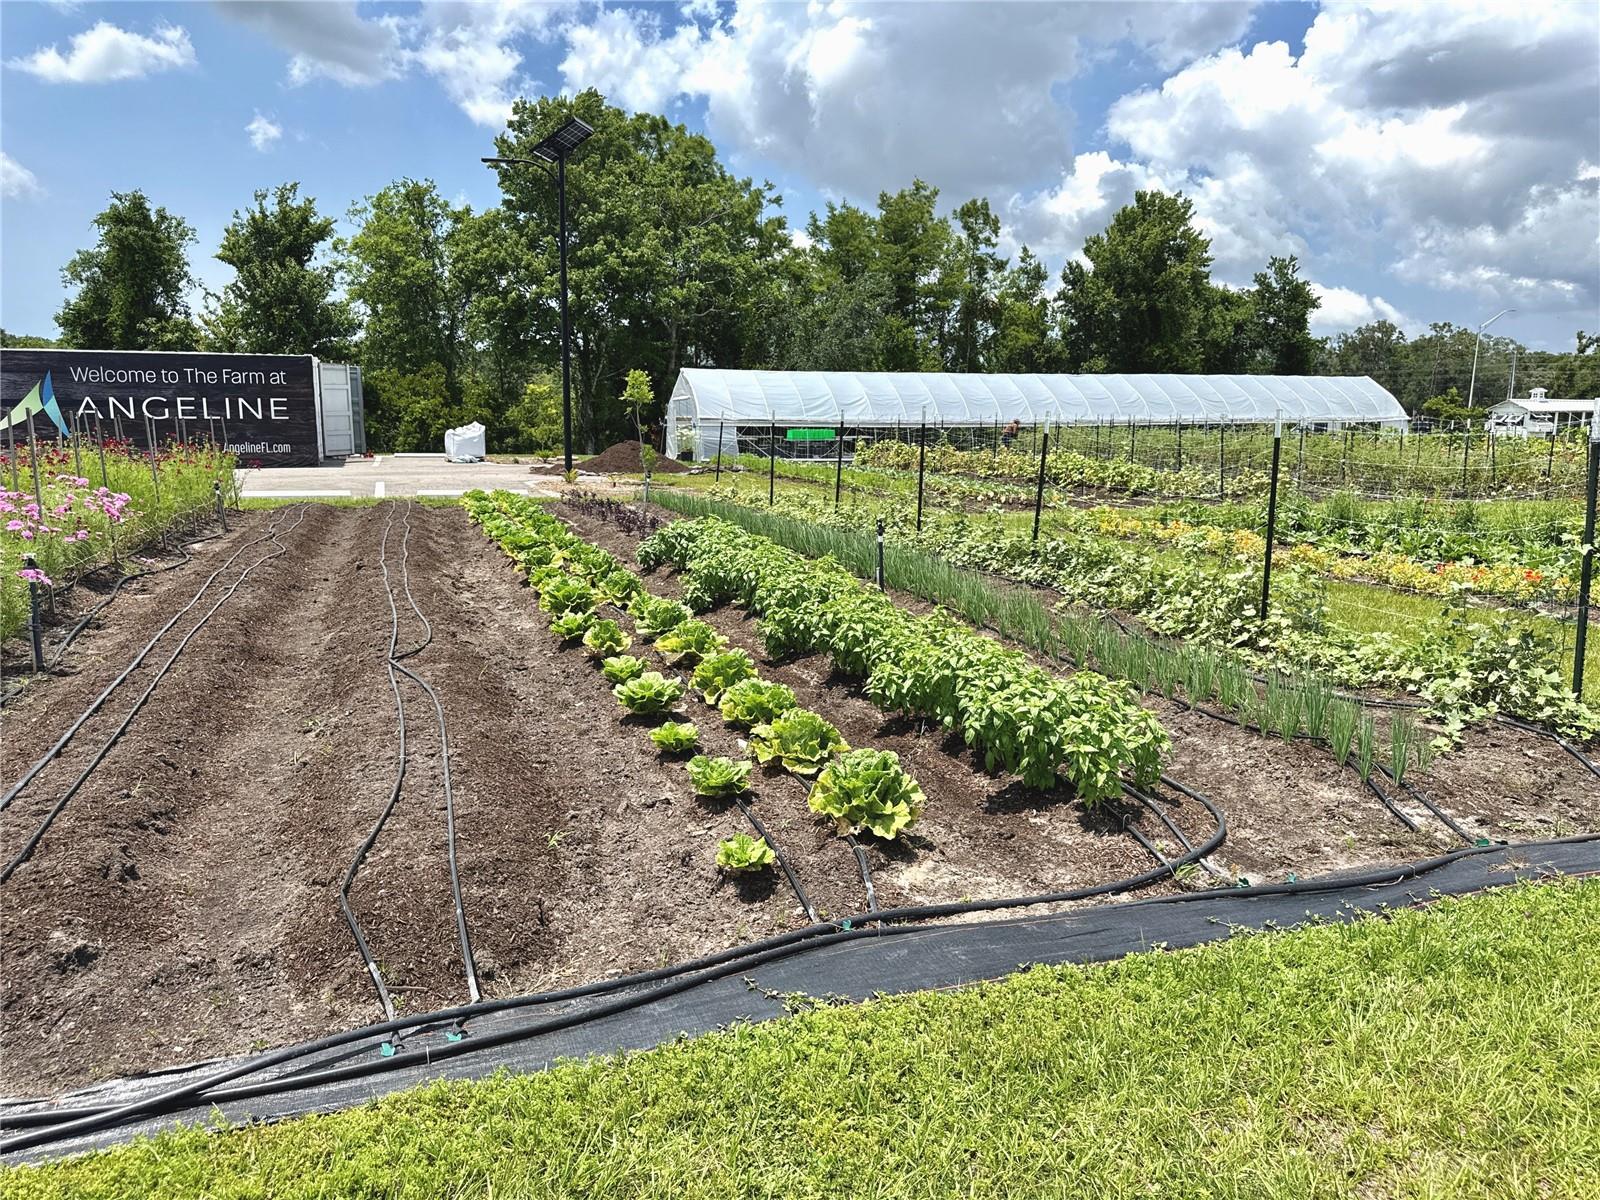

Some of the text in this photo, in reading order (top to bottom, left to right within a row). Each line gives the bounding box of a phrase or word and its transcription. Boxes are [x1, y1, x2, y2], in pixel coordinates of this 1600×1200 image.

[69, 366, 287, 385] Welcome to The Farm at
[75, 396, 290, 420] ANGELINE
